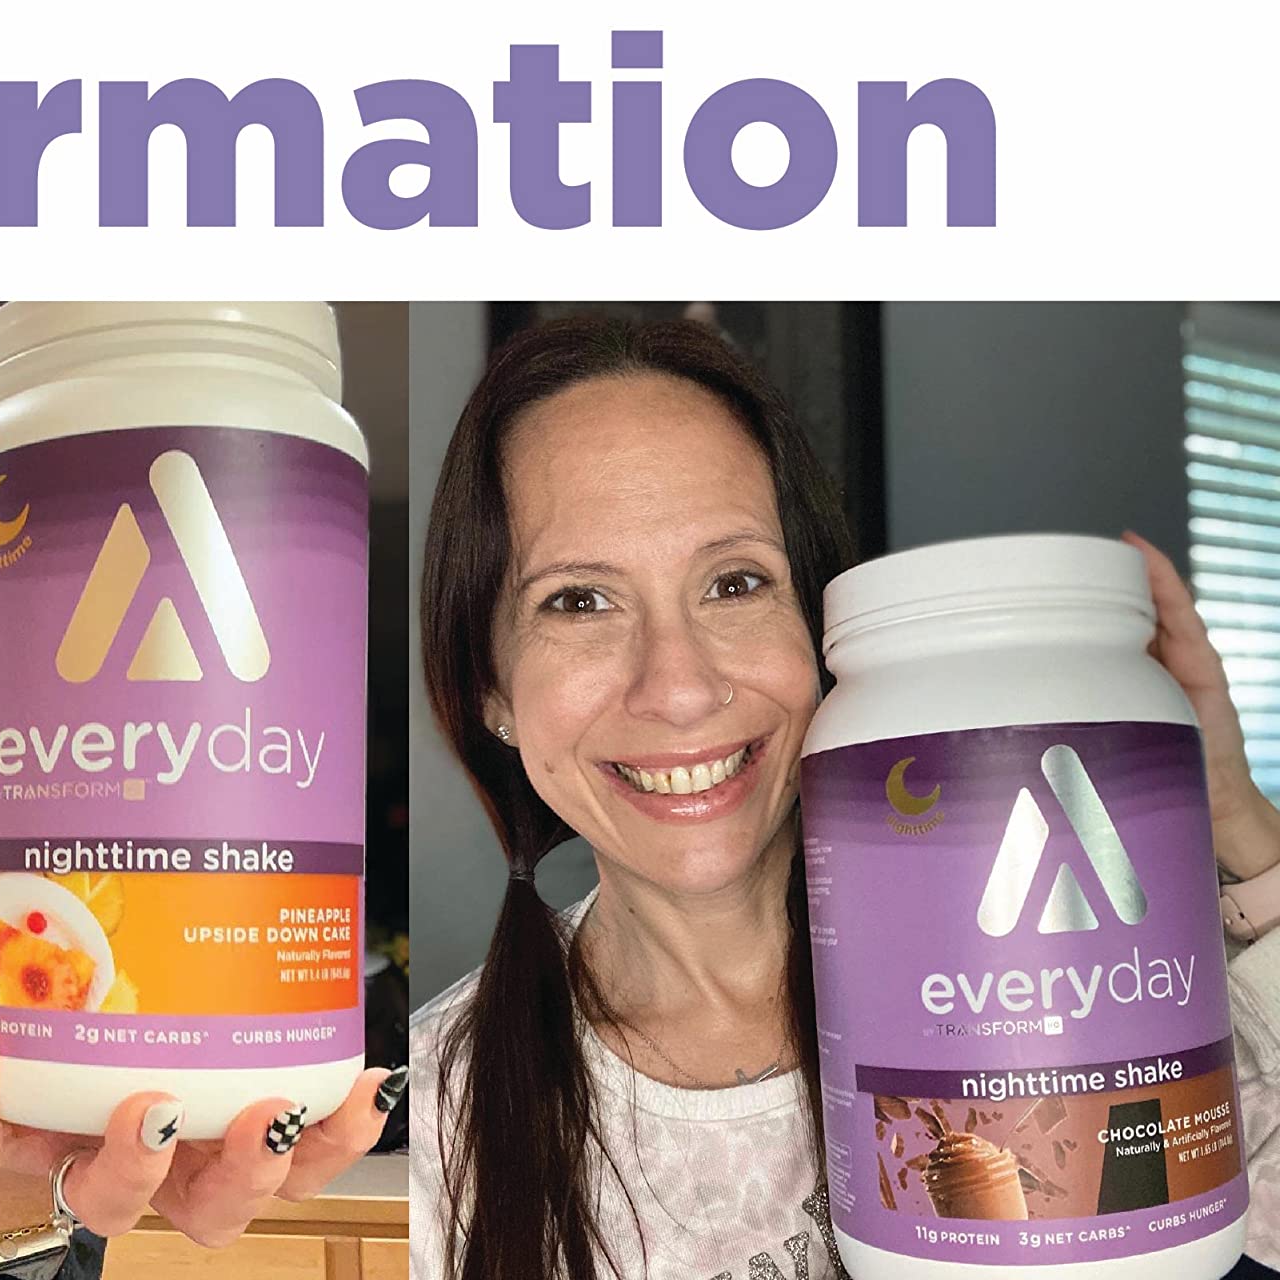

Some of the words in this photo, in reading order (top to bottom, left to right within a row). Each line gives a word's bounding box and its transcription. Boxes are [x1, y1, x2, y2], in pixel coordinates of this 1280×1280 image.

[2, 780, 120, 800] TRANSFORM
[24, 840, 192, 874] nighttime
[202, 841, 294, 872] shake
[279, 908, 351, 924] PINEAPPLE
[183, 927, 259, 943] UPSIDE
[266, 927, 319, 942] DOWN
[322, 926, 351, 941] CAKE
[276, 949, 321, 963] Naturally
[921, 946, 1195, 1019] everyday
[74, 1024, 99, 1044] 2g
[104, 1028, 137, 1044] NET
[232, 1030, 283, 1045] CURBS
[961, 1070, 1106, 1102] nighttime
[1114, 1058, 1183, 1089] shake
[1097, 1116, 1191, 1144] CHOCOLATE
[1194, 1101, 1230, 1126] MOUSSE
[1116, 1141, 1161, 1158] Naturally
[1163, 1138, 1170, 1149] &
[1172, 1128, 1210, 1148] Artificially
[1178, 1150, 1190, 1164] NET
[1148, 1216, 1187, 1233] CURBS
[915, 1225, 938, 1243] 11g
[940, 1231, 1000, 1246] PROTEIN
[1019, 1231, 1042, 1248] 3g
[1045, 1231, 1074, 1245] NET
